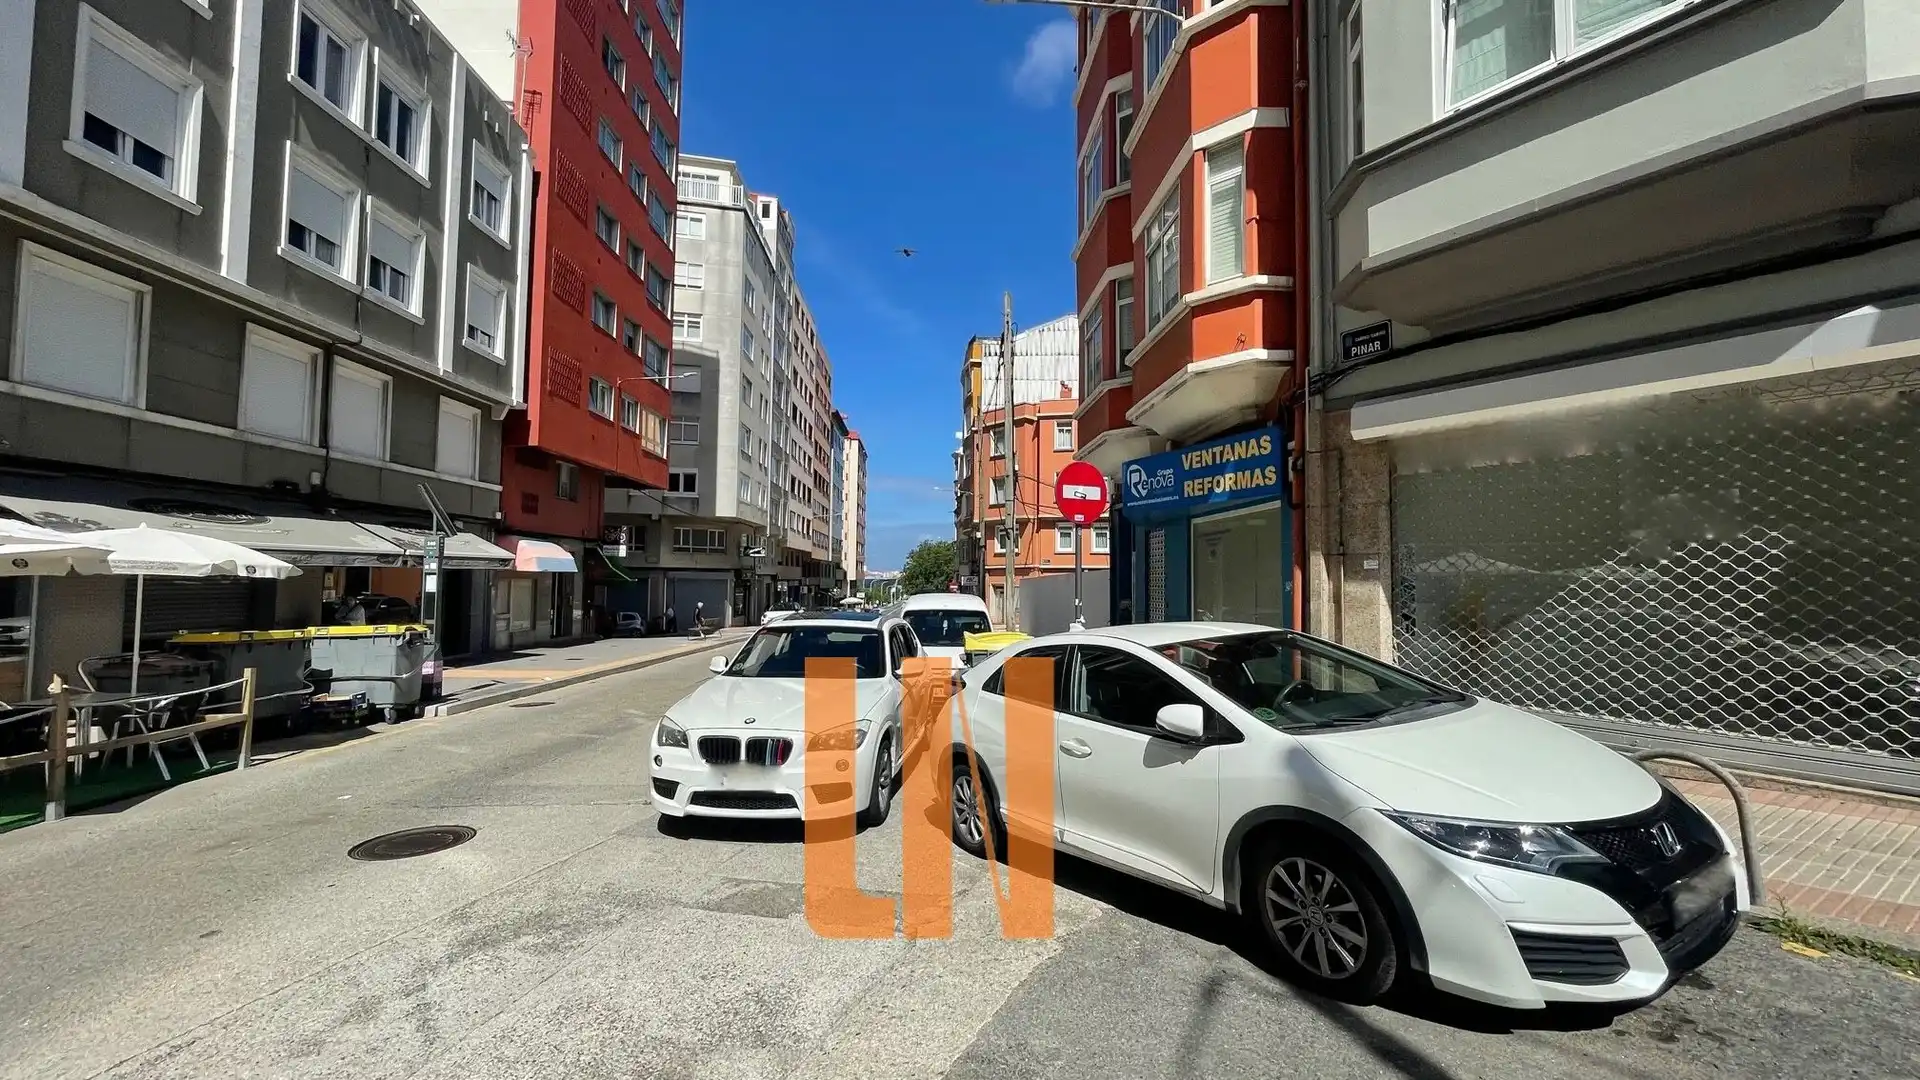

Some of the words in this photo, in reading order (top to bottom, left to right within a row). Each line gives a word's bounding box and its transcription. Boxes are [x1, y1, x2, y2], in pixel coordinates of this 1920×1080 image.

[1351, 341, 1381, 357] PINAR
[1181, 435, 1272, 471] VENTANAS
[1129, 468, 1175, 498] Renova
[1156, 468, 1174, 476] Grupo
[1183, 465, 1277, 498] REFORMAS
